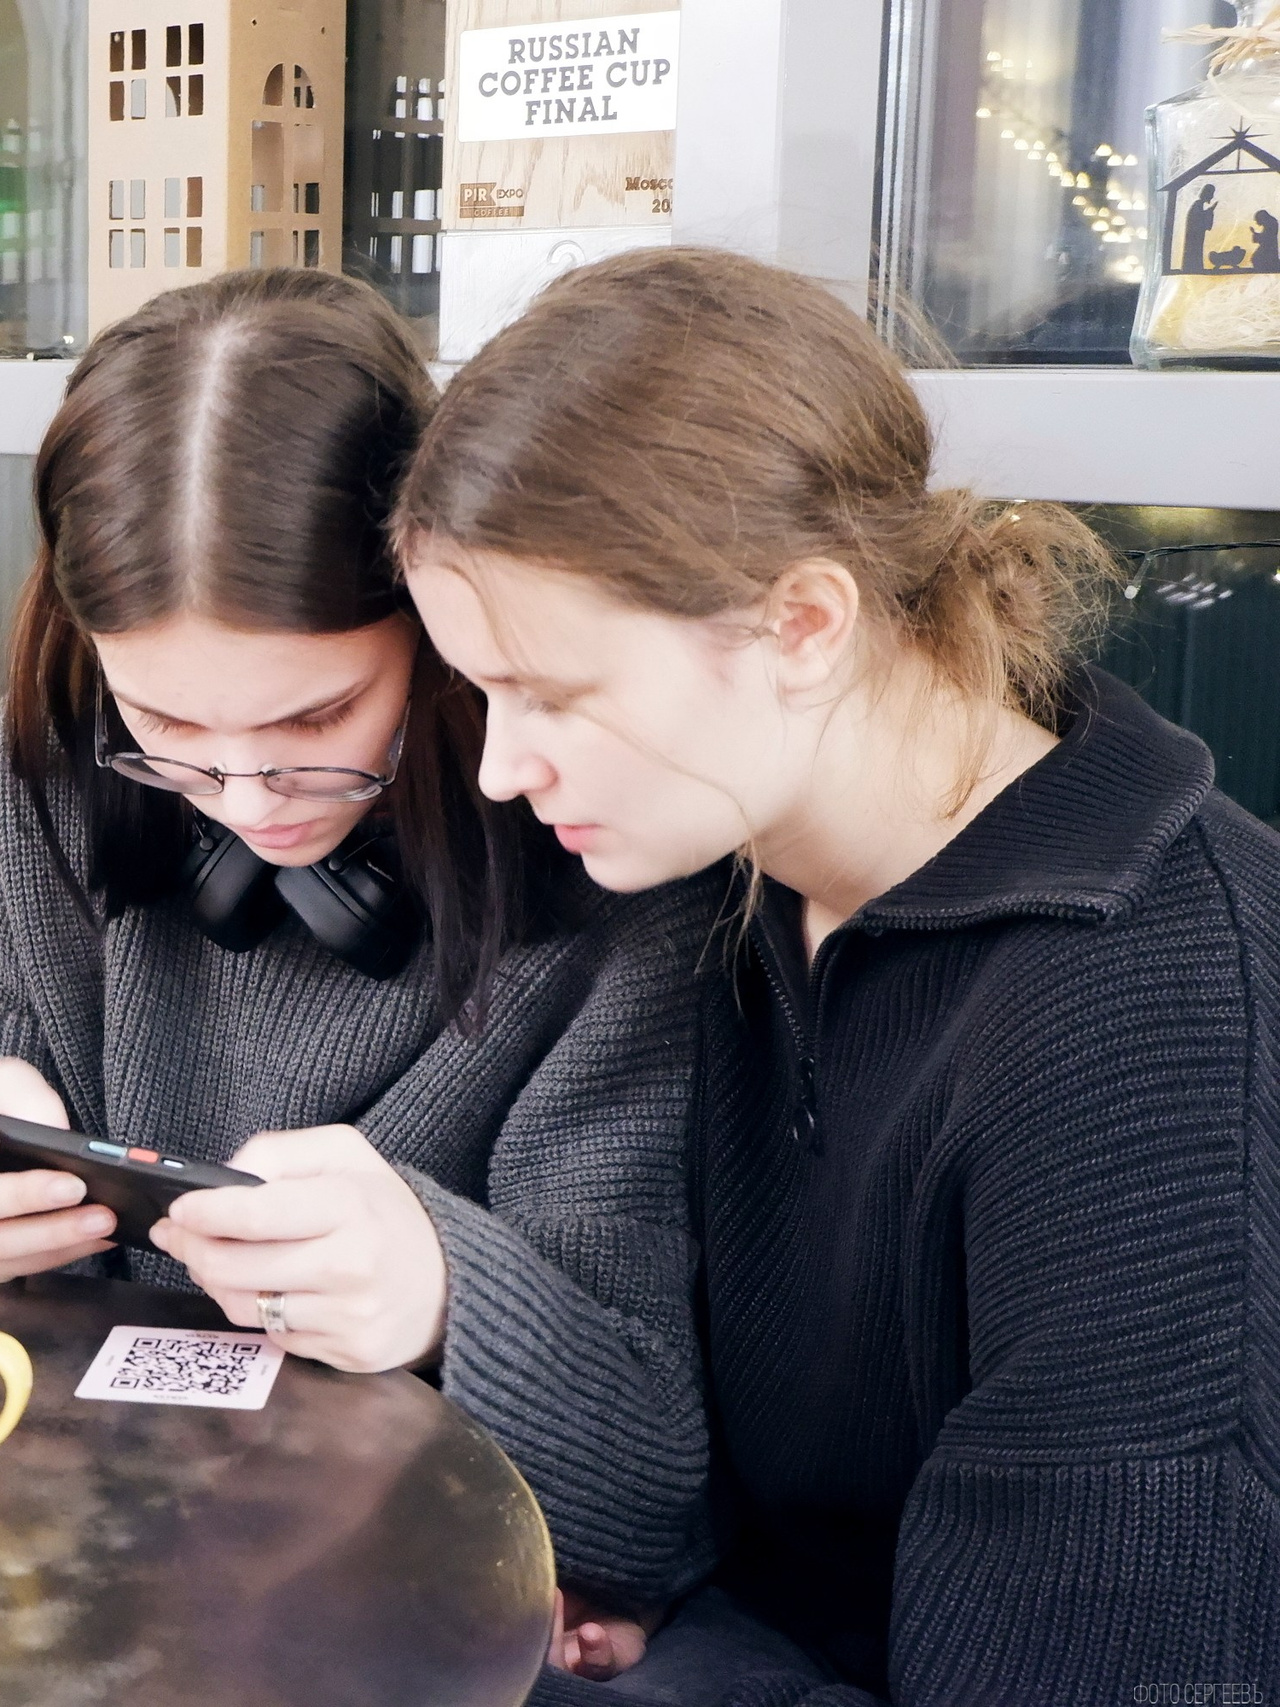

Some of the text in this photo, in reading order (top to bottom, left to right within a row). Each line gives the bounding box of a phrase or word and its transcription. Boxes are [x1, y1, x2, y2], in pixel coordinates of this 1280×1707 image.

[508, 28, 640, 64] RUSSIAN
[478, 58, 671, 97] COFFEE CUP
[524, 95, 618, 126] FINAL
[496, 188, 525, 199] EXPO
[625, 176, 674, 192] Mosco
[474, 208, 510, 217] COFFEE
